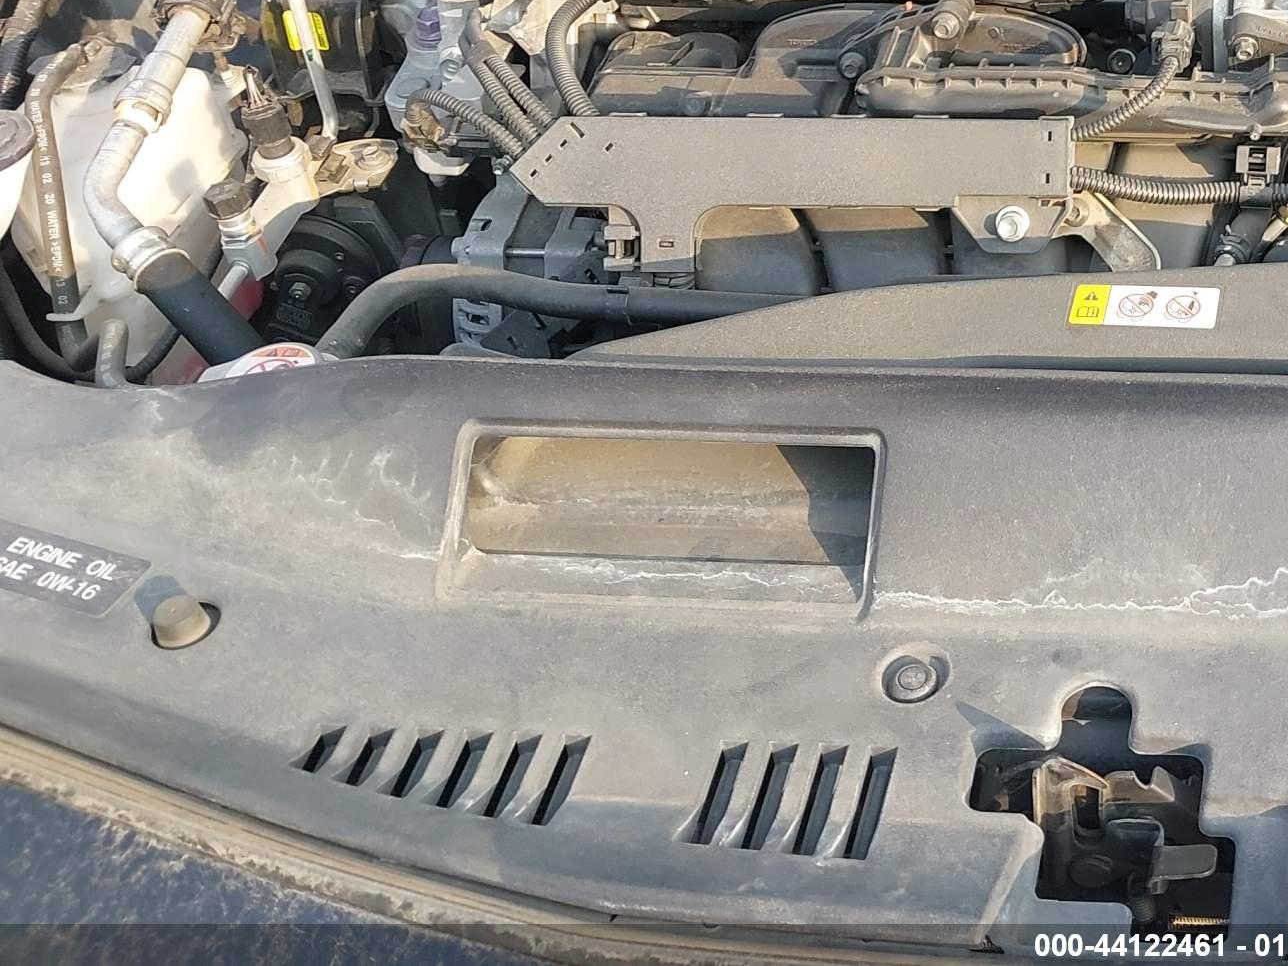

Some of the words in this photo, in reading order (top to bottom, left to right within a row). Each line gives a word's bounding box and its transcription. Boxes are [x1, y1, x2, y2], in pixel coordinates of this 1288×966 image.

[46, 210, 58, 240] WATER
[6, 536, 83, 569] ENGINE
[85, 559, 118, 581] OIL
[36, 571, 101, 601] 0W-16
